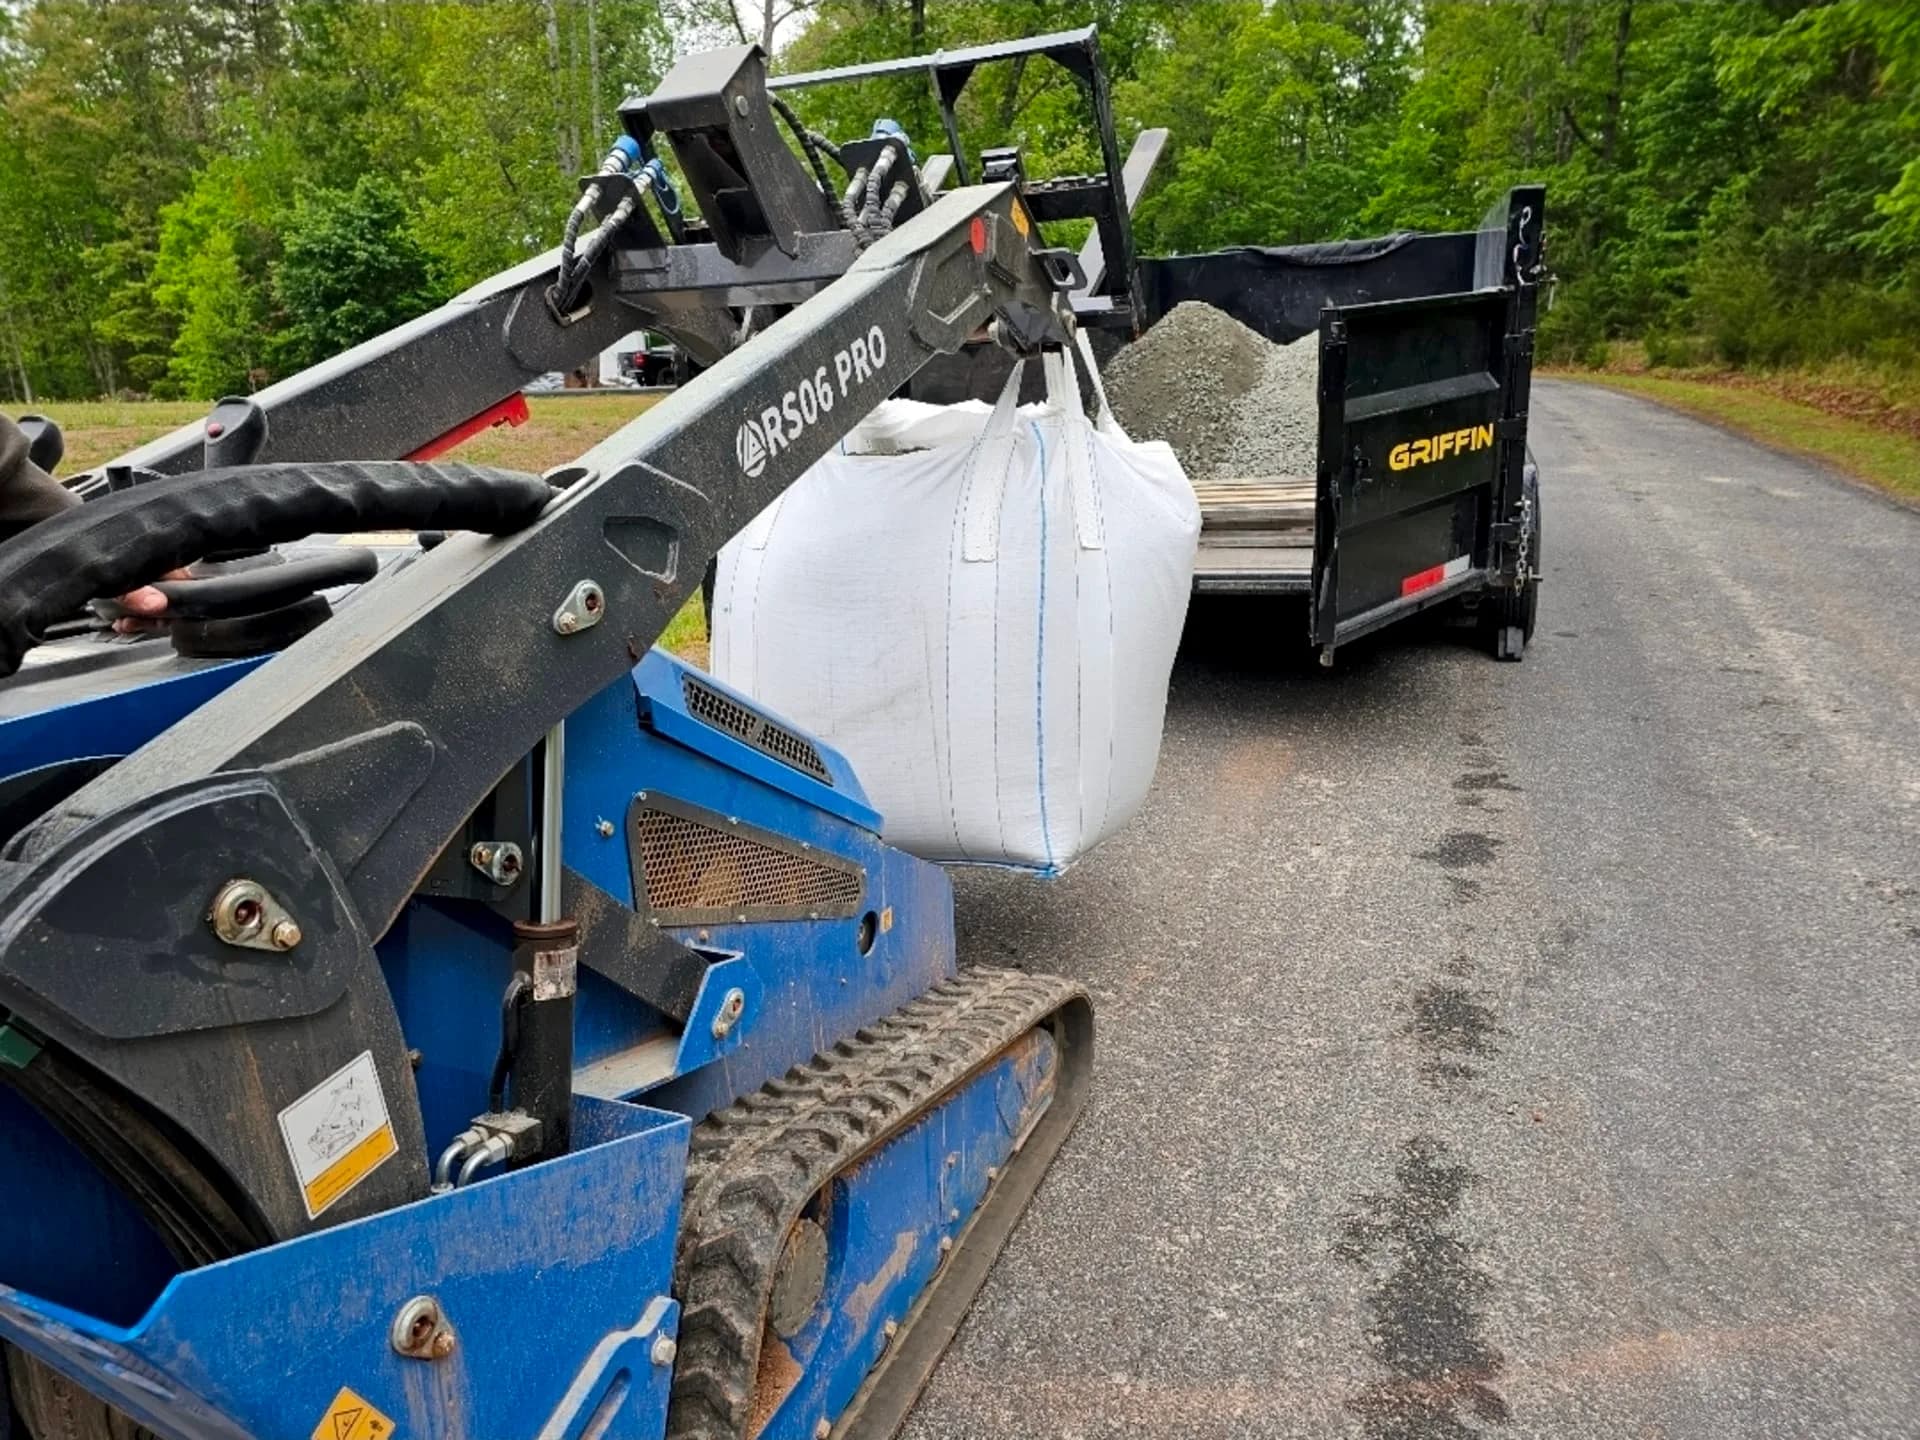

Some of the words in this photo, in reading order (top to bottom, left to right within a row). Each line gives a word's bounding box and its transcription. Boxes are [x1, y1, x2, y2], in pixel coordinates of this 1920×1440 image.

[761, 366, 833, 457] RS06
[834, 325, 886, 397] PRO
[1389, 423, 1494, 470] GRIFFIN
